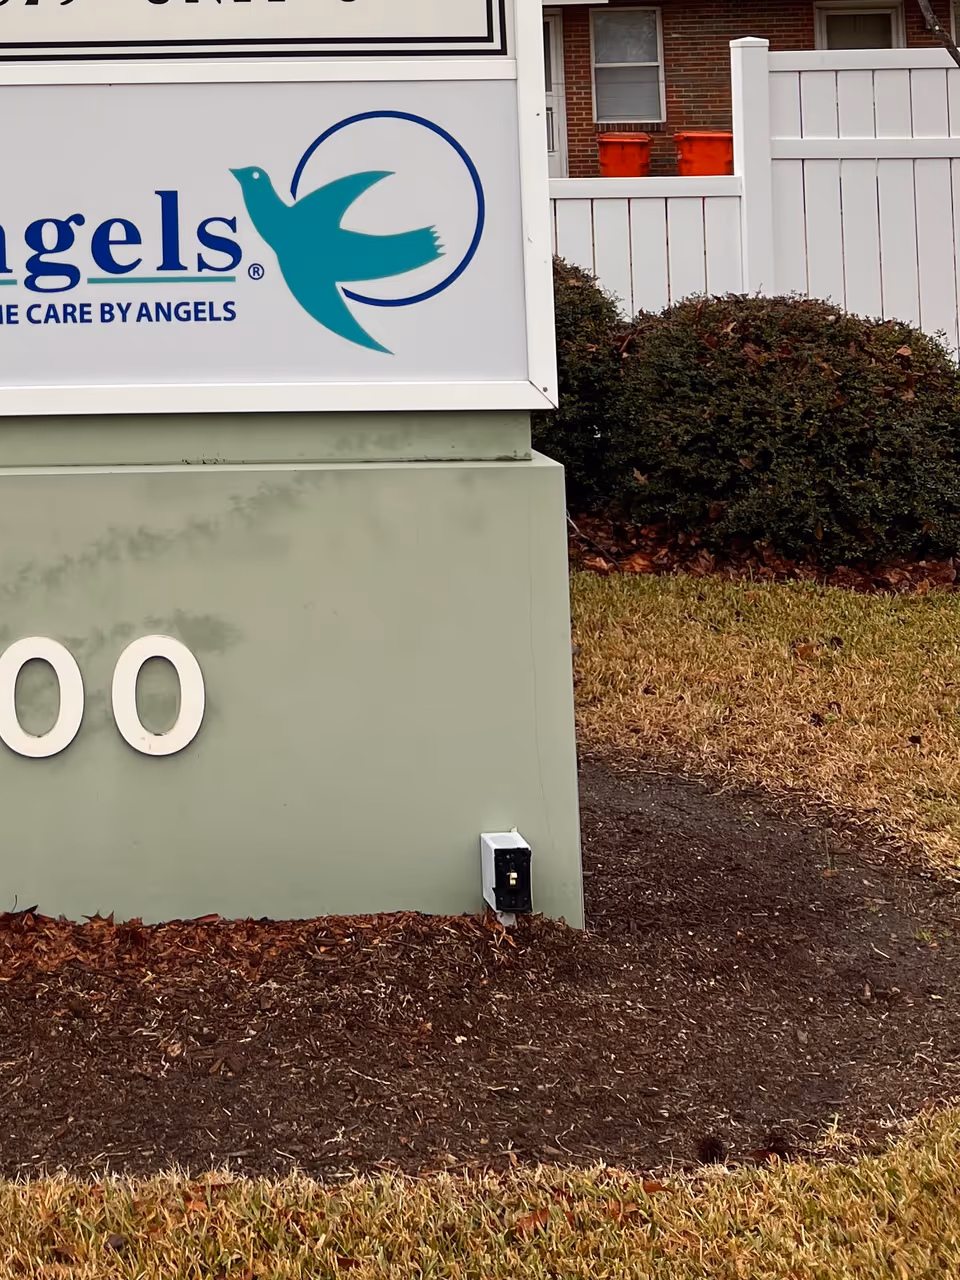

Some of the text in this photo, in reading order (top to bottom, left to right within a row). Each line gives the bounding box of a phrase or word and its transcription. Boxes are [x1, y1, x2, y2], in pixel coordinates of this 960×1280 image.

[26, 303, 93, 325] CARE
[100, 302, 132, 323] BY
[135, 300, 237, 323] ANGELS
